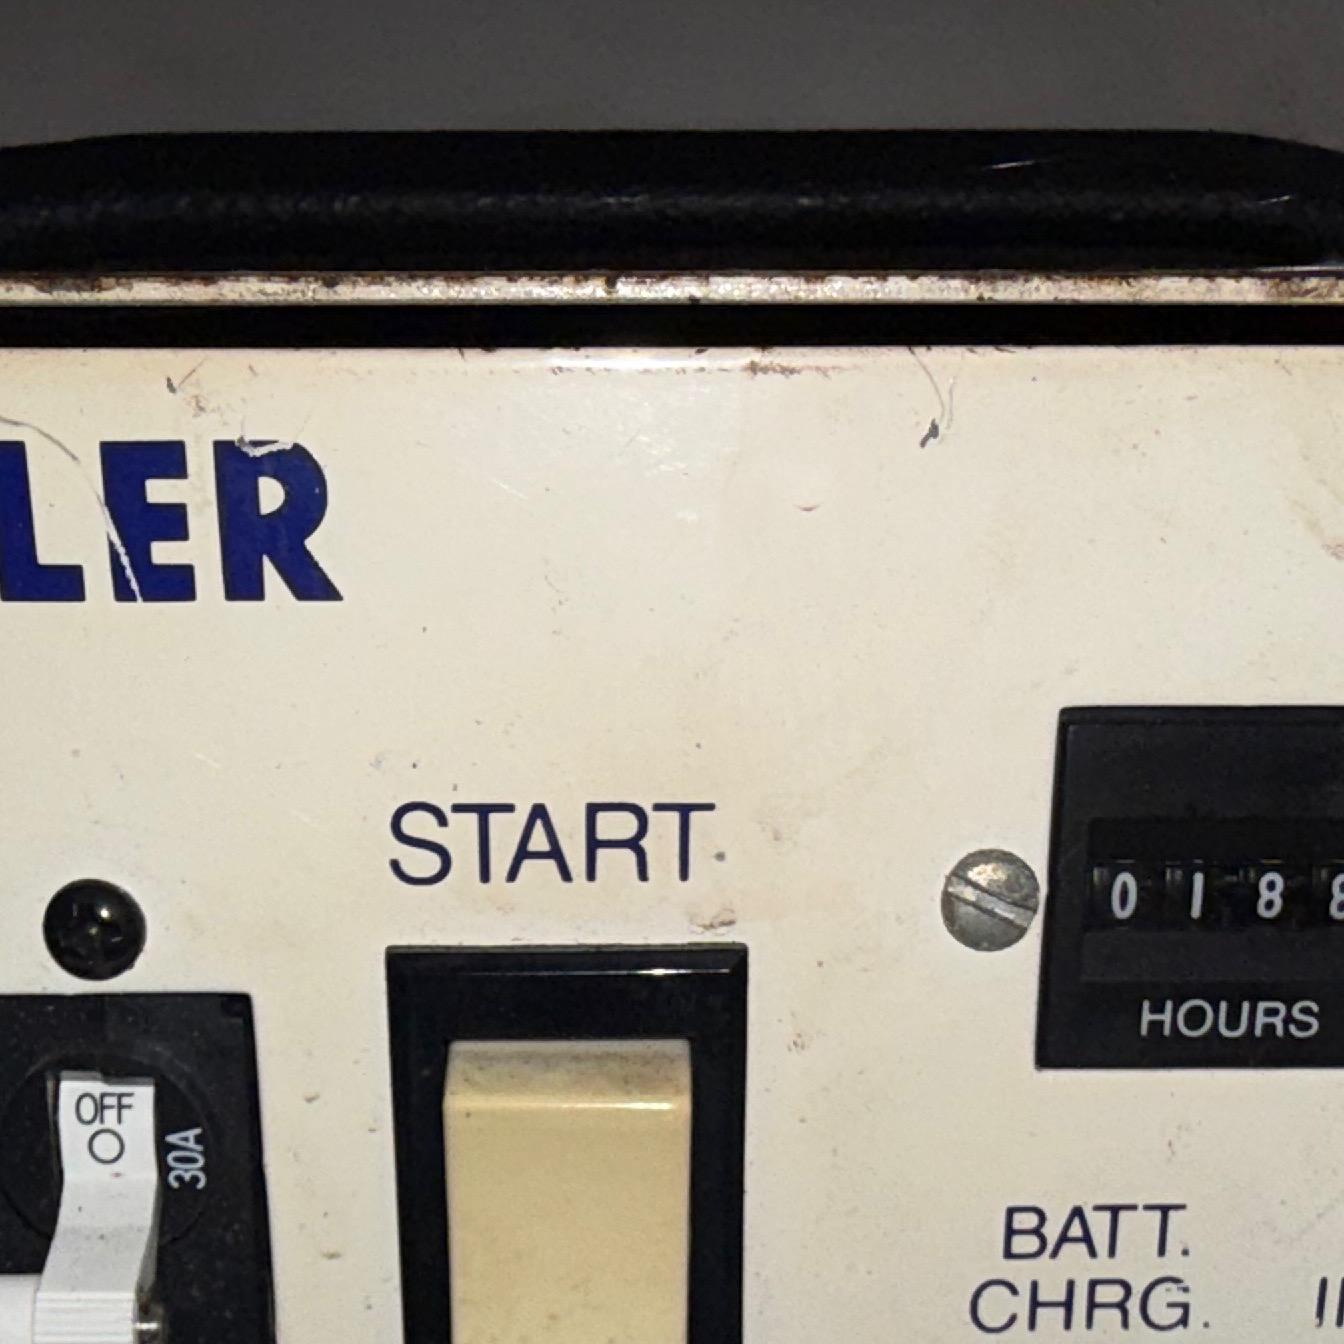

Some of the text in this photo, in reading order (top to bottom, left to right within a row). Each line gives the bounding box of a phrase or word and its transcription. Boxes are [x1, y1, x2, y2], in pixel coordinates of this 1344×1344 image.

[388, 801, 717, 886] START
[1139, 999, 1321, 1038] HOURS
[74, 1091, 135, 1126] OFF
[164, 1126, 208, 1191] 30A
[1001, 1203, 1192, 1260] BATT.
[968, 1275, 1211, 1334] CHRG.
